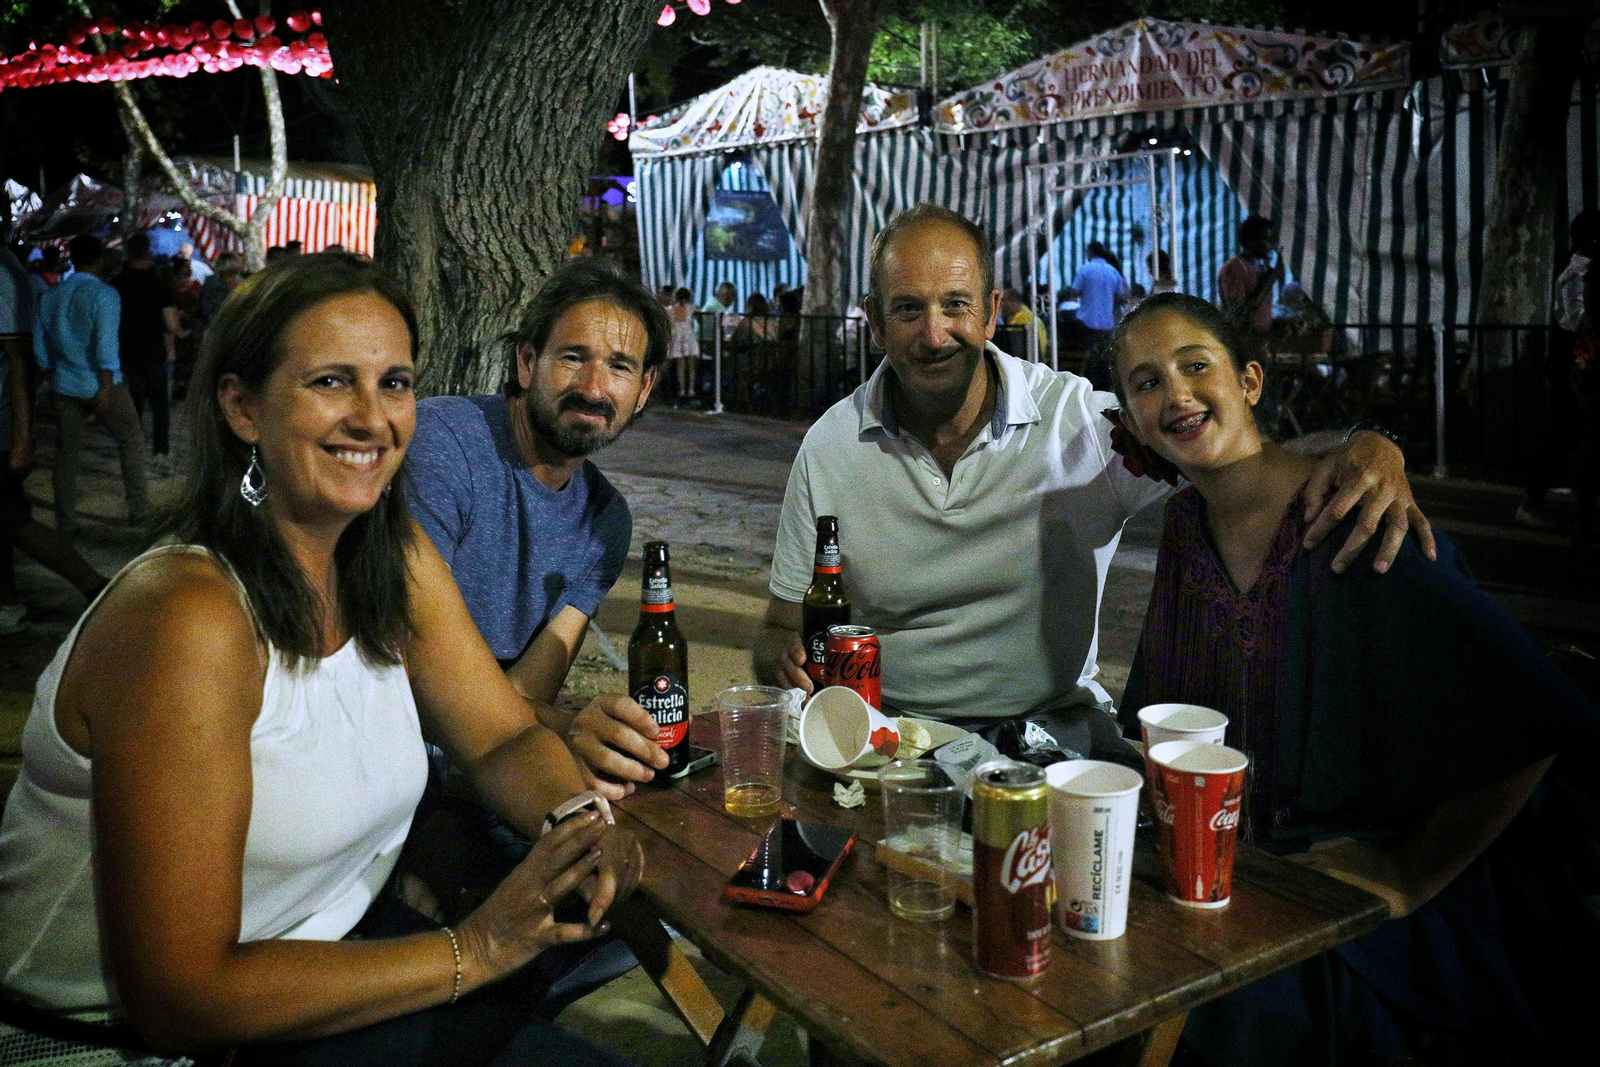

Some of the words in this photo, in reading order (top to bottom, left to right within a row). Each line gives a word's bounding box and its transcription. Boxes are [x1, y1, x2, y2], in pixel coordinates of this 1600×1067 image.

[1187, 48, 1219, 76] DEL
[638, 694, 684, 709] Estrella
[650, 708, 683, 724] alicia
[1090, 829, 1104, 900] RECÍCLAME
